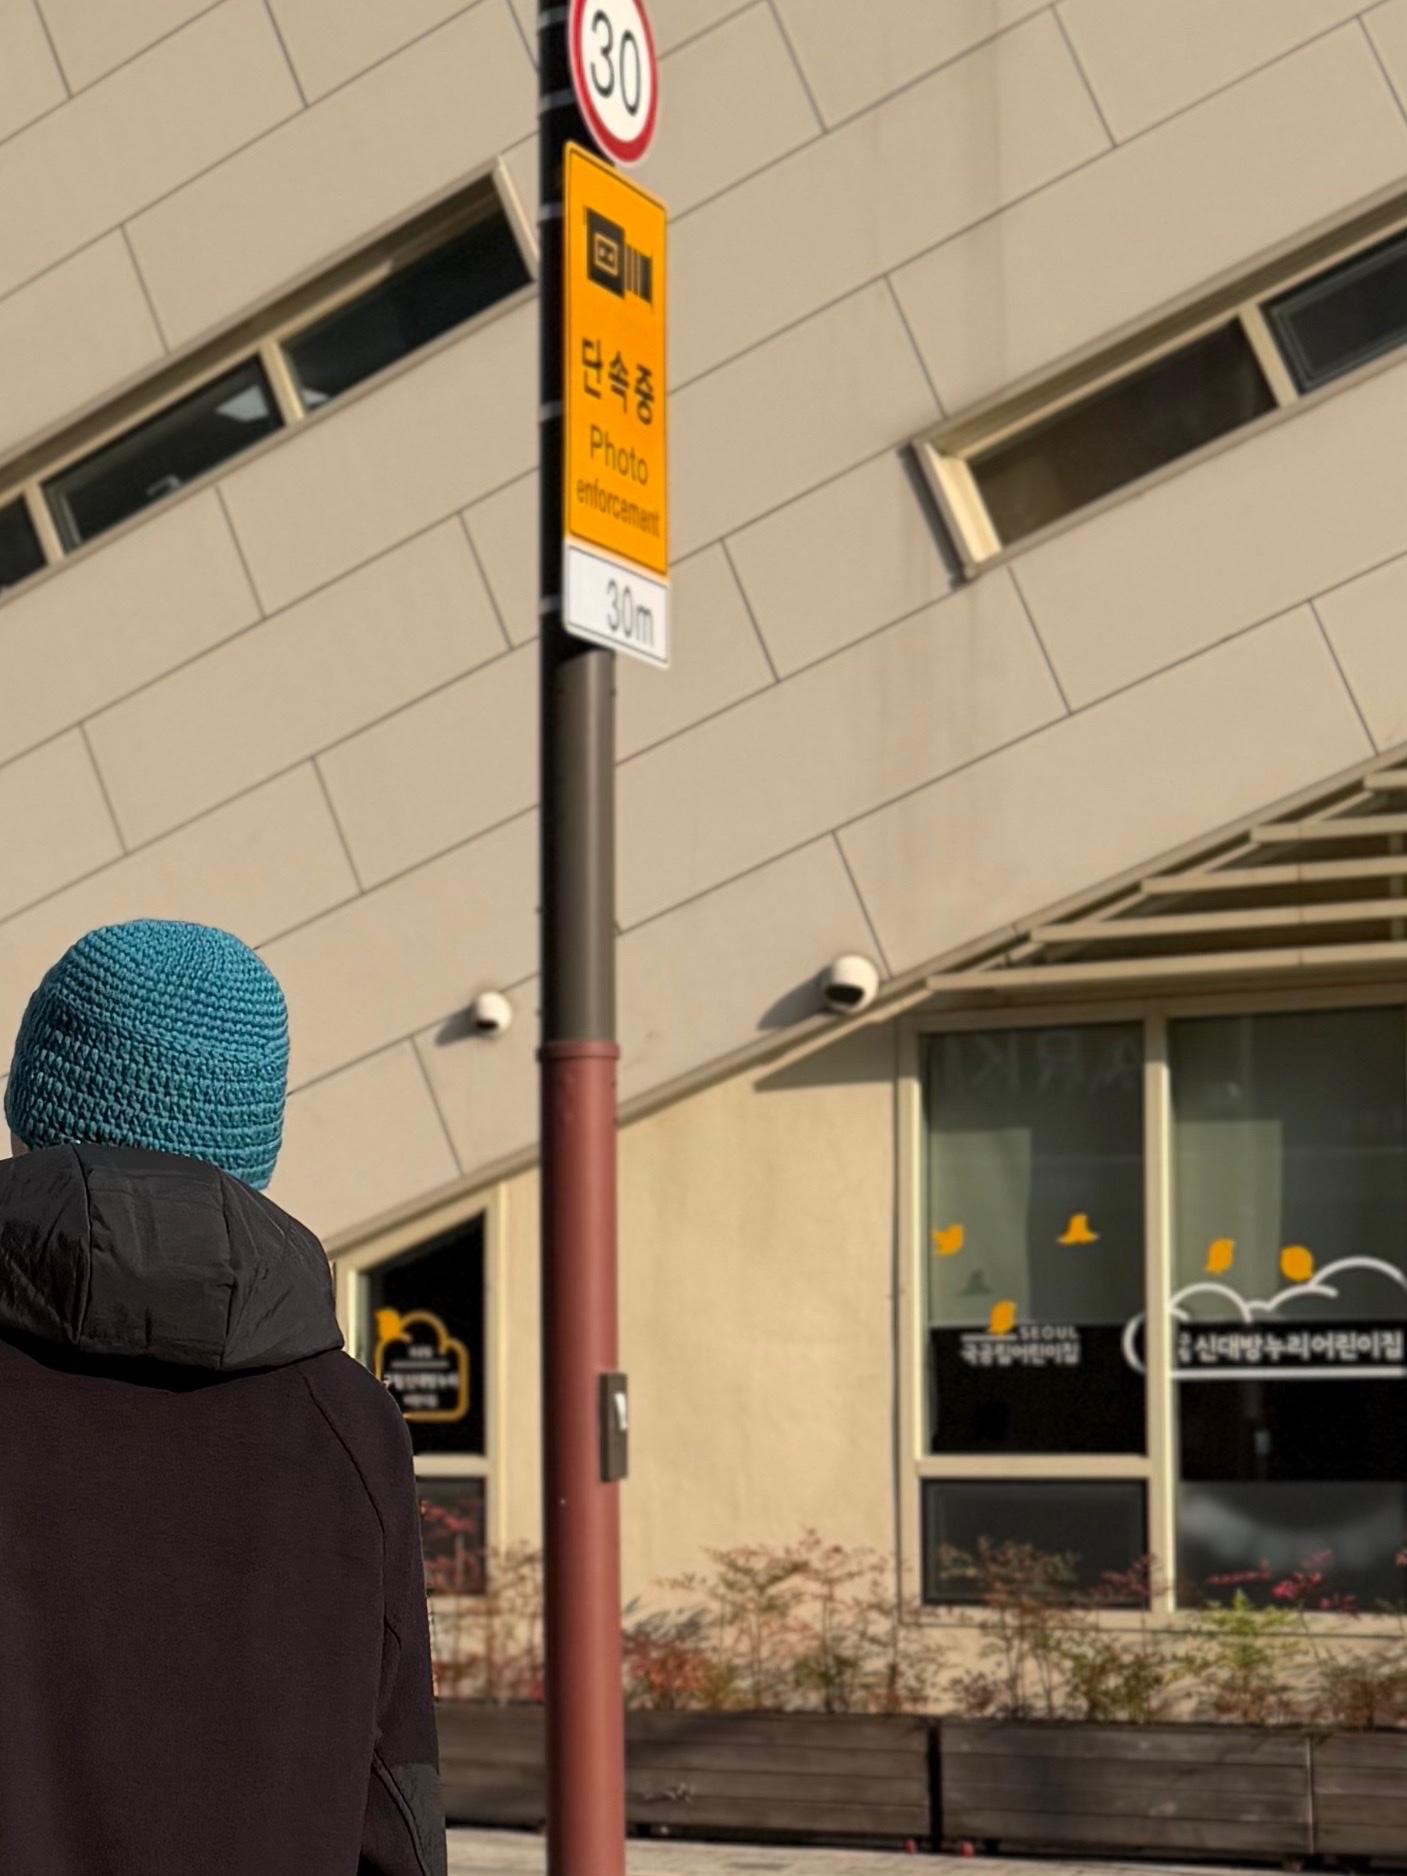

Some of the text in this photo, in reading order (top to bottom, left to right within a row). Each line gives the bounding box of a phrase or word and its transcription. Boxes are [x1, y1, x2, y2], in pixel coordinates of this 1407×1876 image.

[590, 9, 641, 116] 30
[581, 336, 655, 426] 단속중
[589, 424, 649, 486] Photo
[576, 478, 660, 538] enforcement
[606, 579, 655, 648] 30m
[1019, 1325, 1079, 1341] SEOUL
